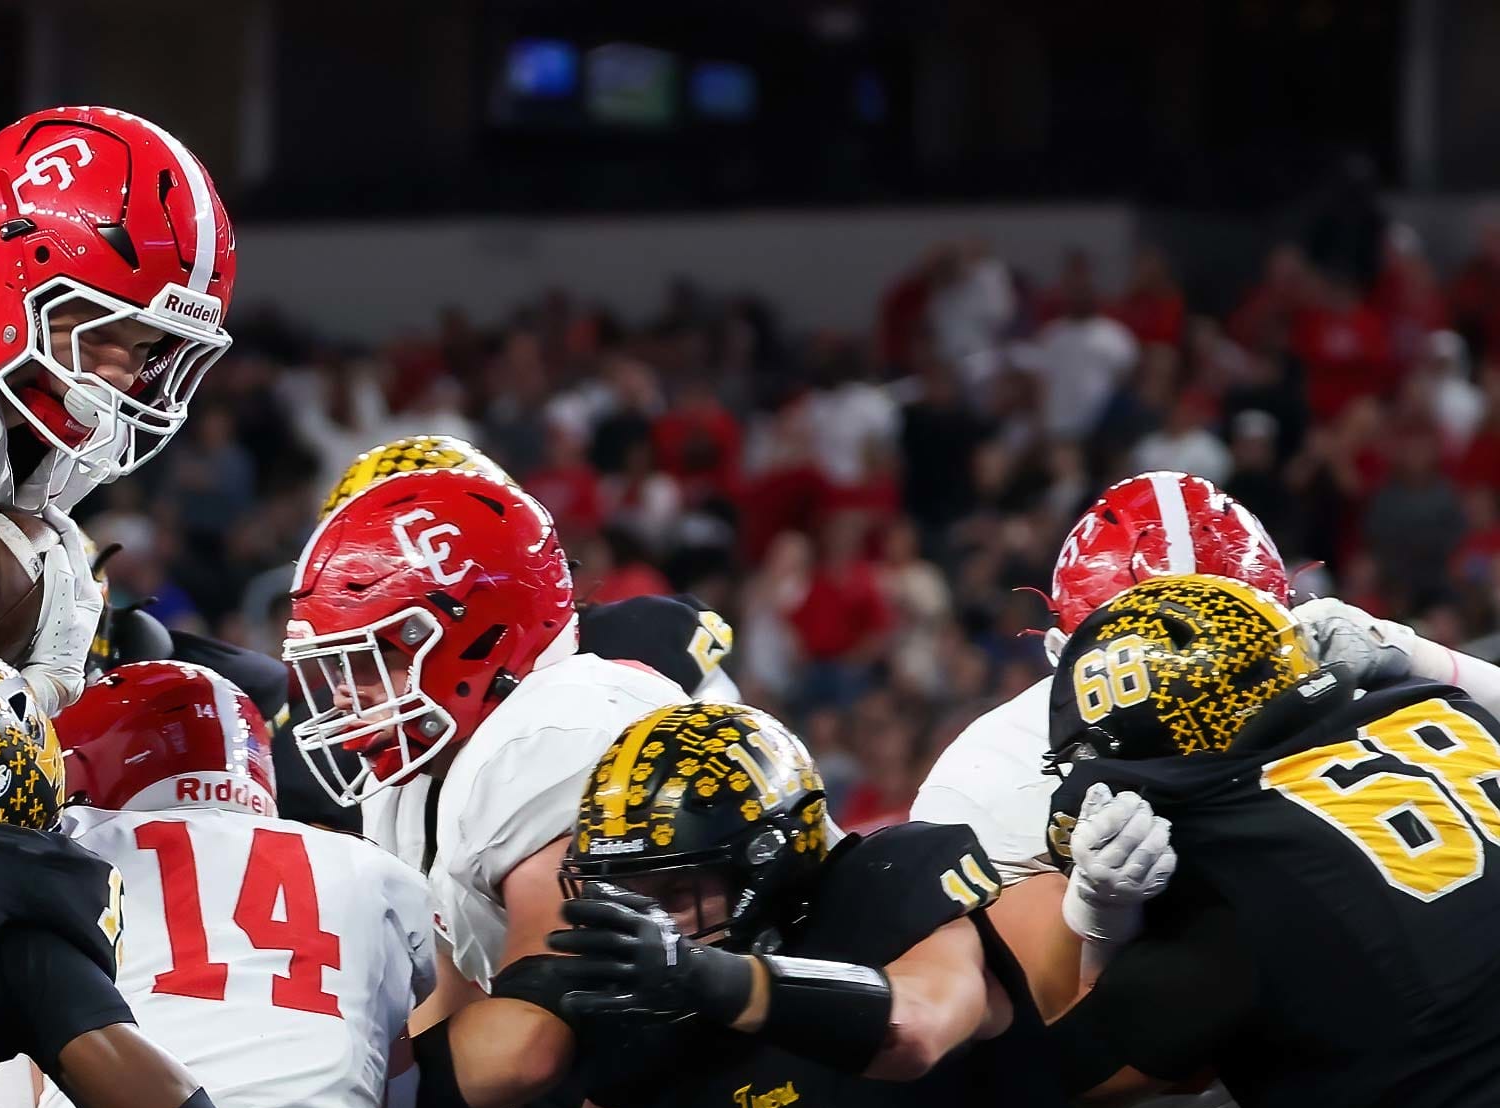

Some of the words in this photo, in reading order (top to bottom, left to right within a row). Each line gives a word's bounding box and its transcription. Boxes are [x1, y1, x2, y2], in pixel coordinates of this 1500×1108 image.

[165, 294, 220, 325] Riddell
[392, 508, 476, 586] CC
[1073, 634, 1152, 724] 68
[1259, 698, 1500, 903] 68
[134, 820, 343, 1019] 14
[939, 853, 1000, 908] 11
